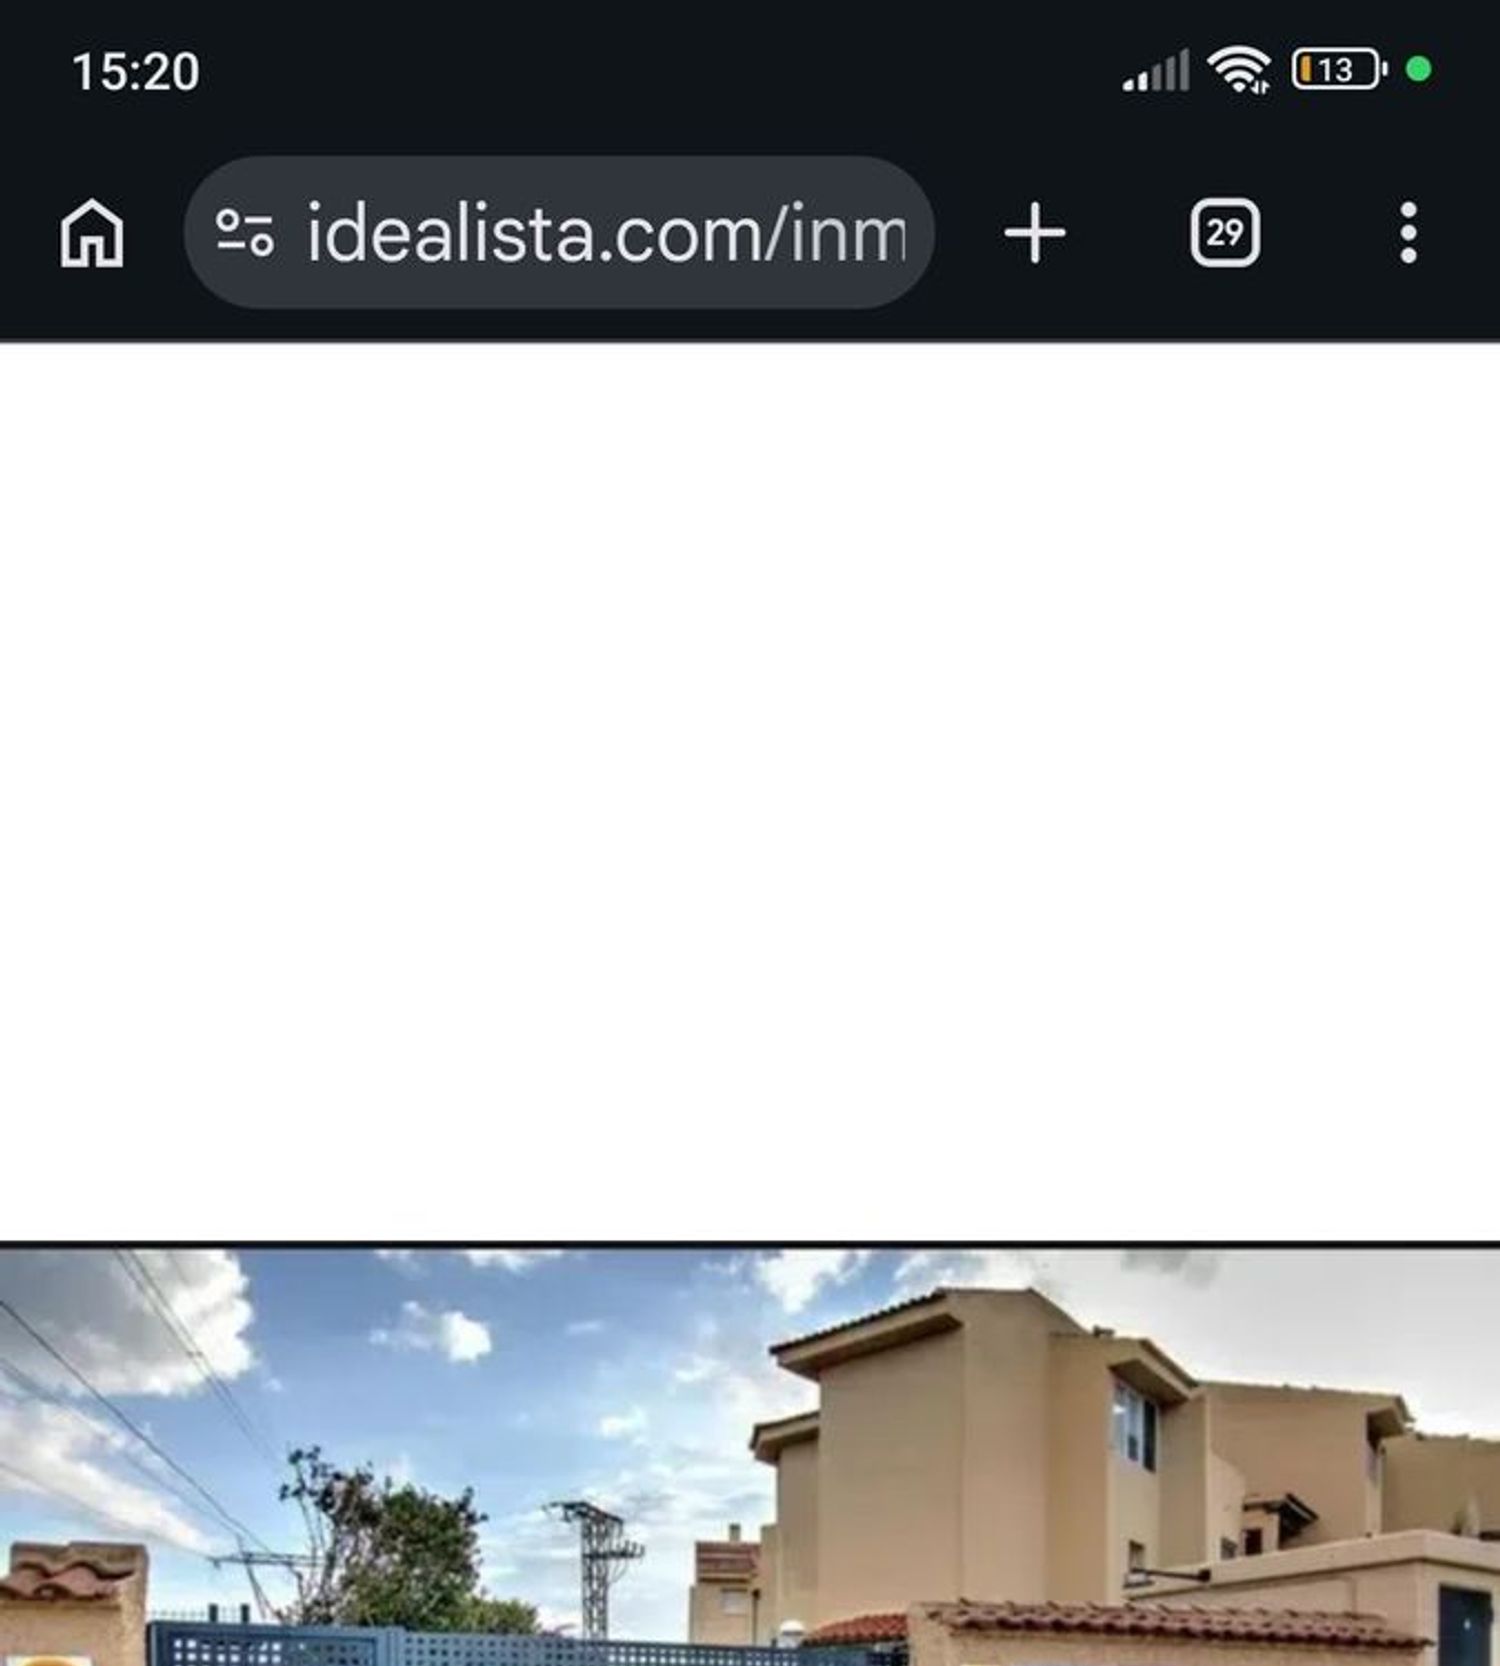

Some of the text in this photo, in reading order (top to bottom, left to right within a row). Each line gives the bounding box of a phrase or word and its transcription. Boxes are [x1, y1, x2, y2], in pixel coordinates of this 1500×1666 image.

[74, 52, 199, 90] 15:20
[1319, 58, 1353, 83] 13
[309, 199, 906, 262] idealista.com/inm
[1206, 218, 1245, 247] 29
